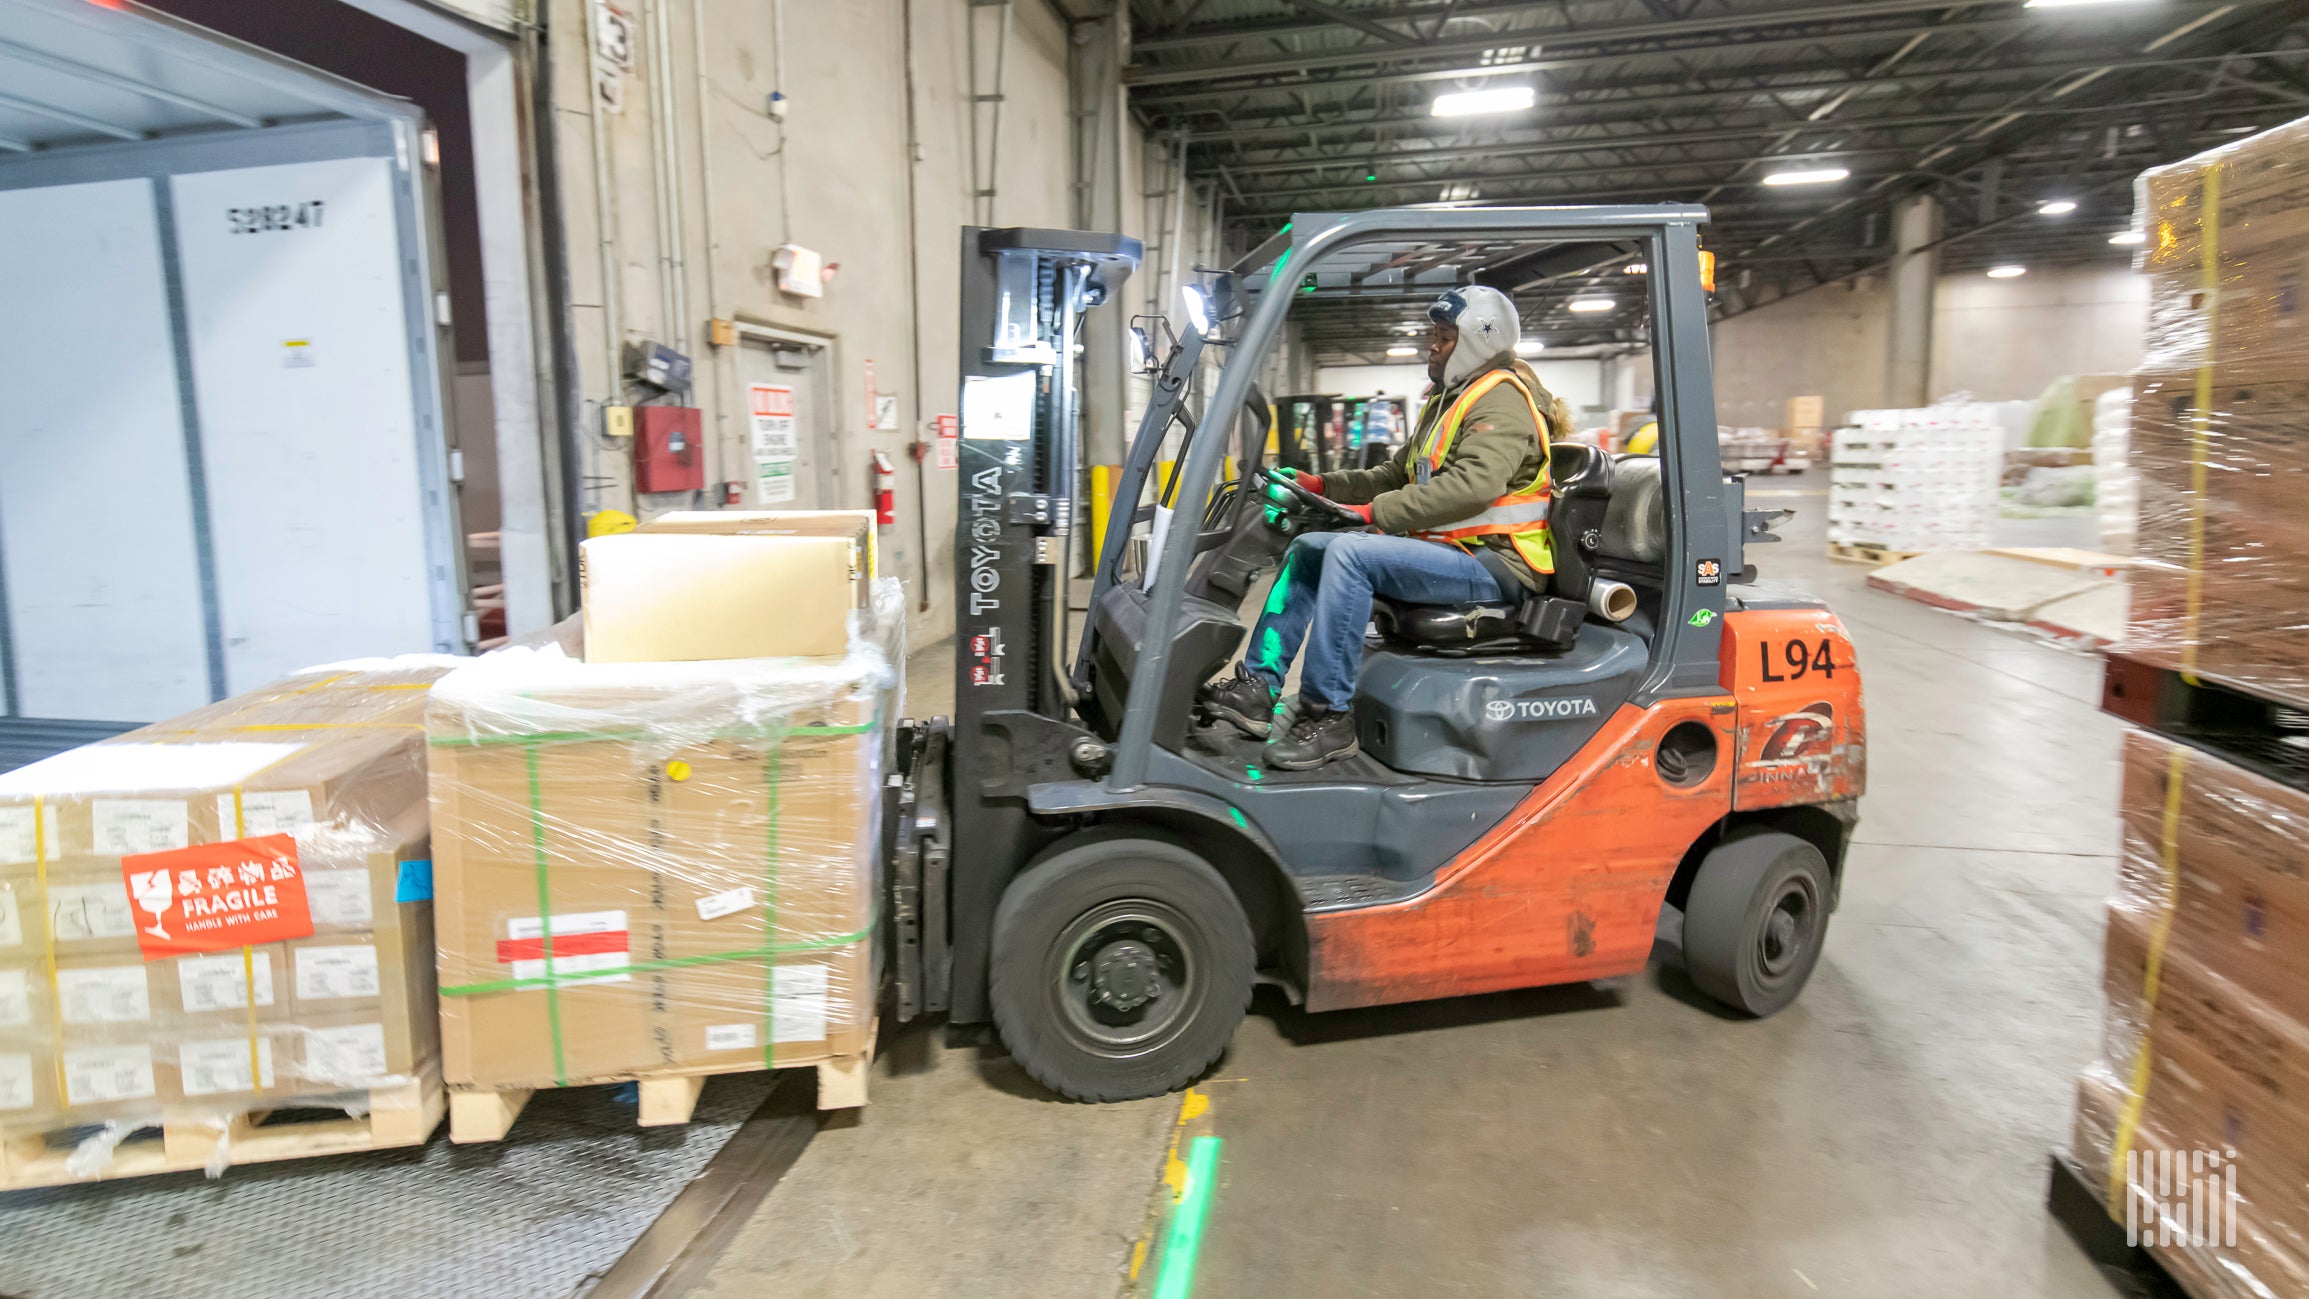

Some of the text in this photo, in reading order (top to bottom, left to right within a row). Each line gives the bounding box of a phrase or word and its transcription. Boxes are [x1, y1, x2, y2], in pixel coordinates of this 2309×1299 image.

[970, 466, 1002, 616] TOYOTA
[1697, 561, 1720, 577] SAS
[1760, 639, 1835, 682] L94
[1517, 699, 1597, 717] TOYOTA
[181, 885, 279, 918] FRAGILE
[185, 908, 279, 932] HANDLE WITH CARE
